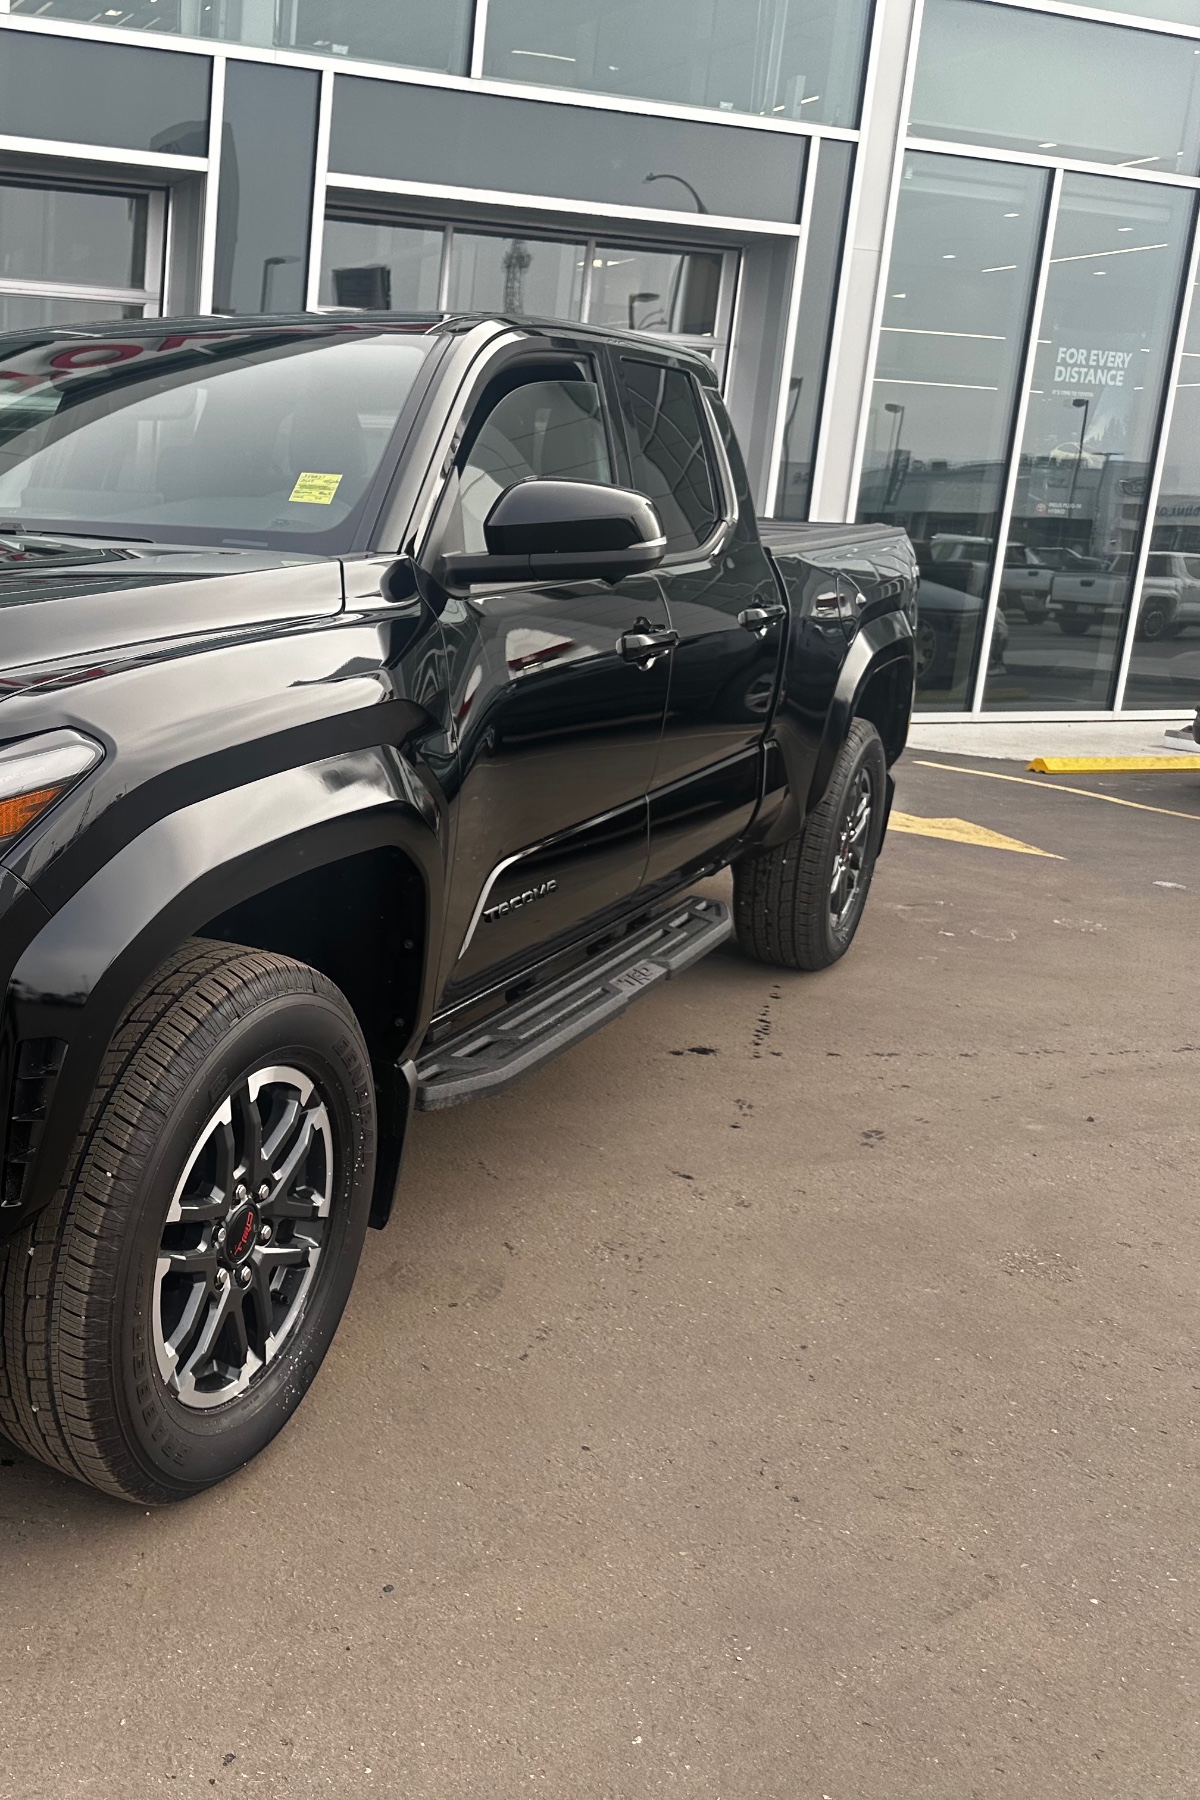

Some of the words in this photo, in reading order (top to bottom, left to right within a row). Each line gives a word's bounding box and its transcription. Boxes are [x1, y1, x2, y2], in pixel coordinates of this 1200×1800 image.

[1057, 347, 1087, 365] FOR
[1089, 350, 1132, 368] EVERY
[1054, 366, 1125, 386] DISTANCE
